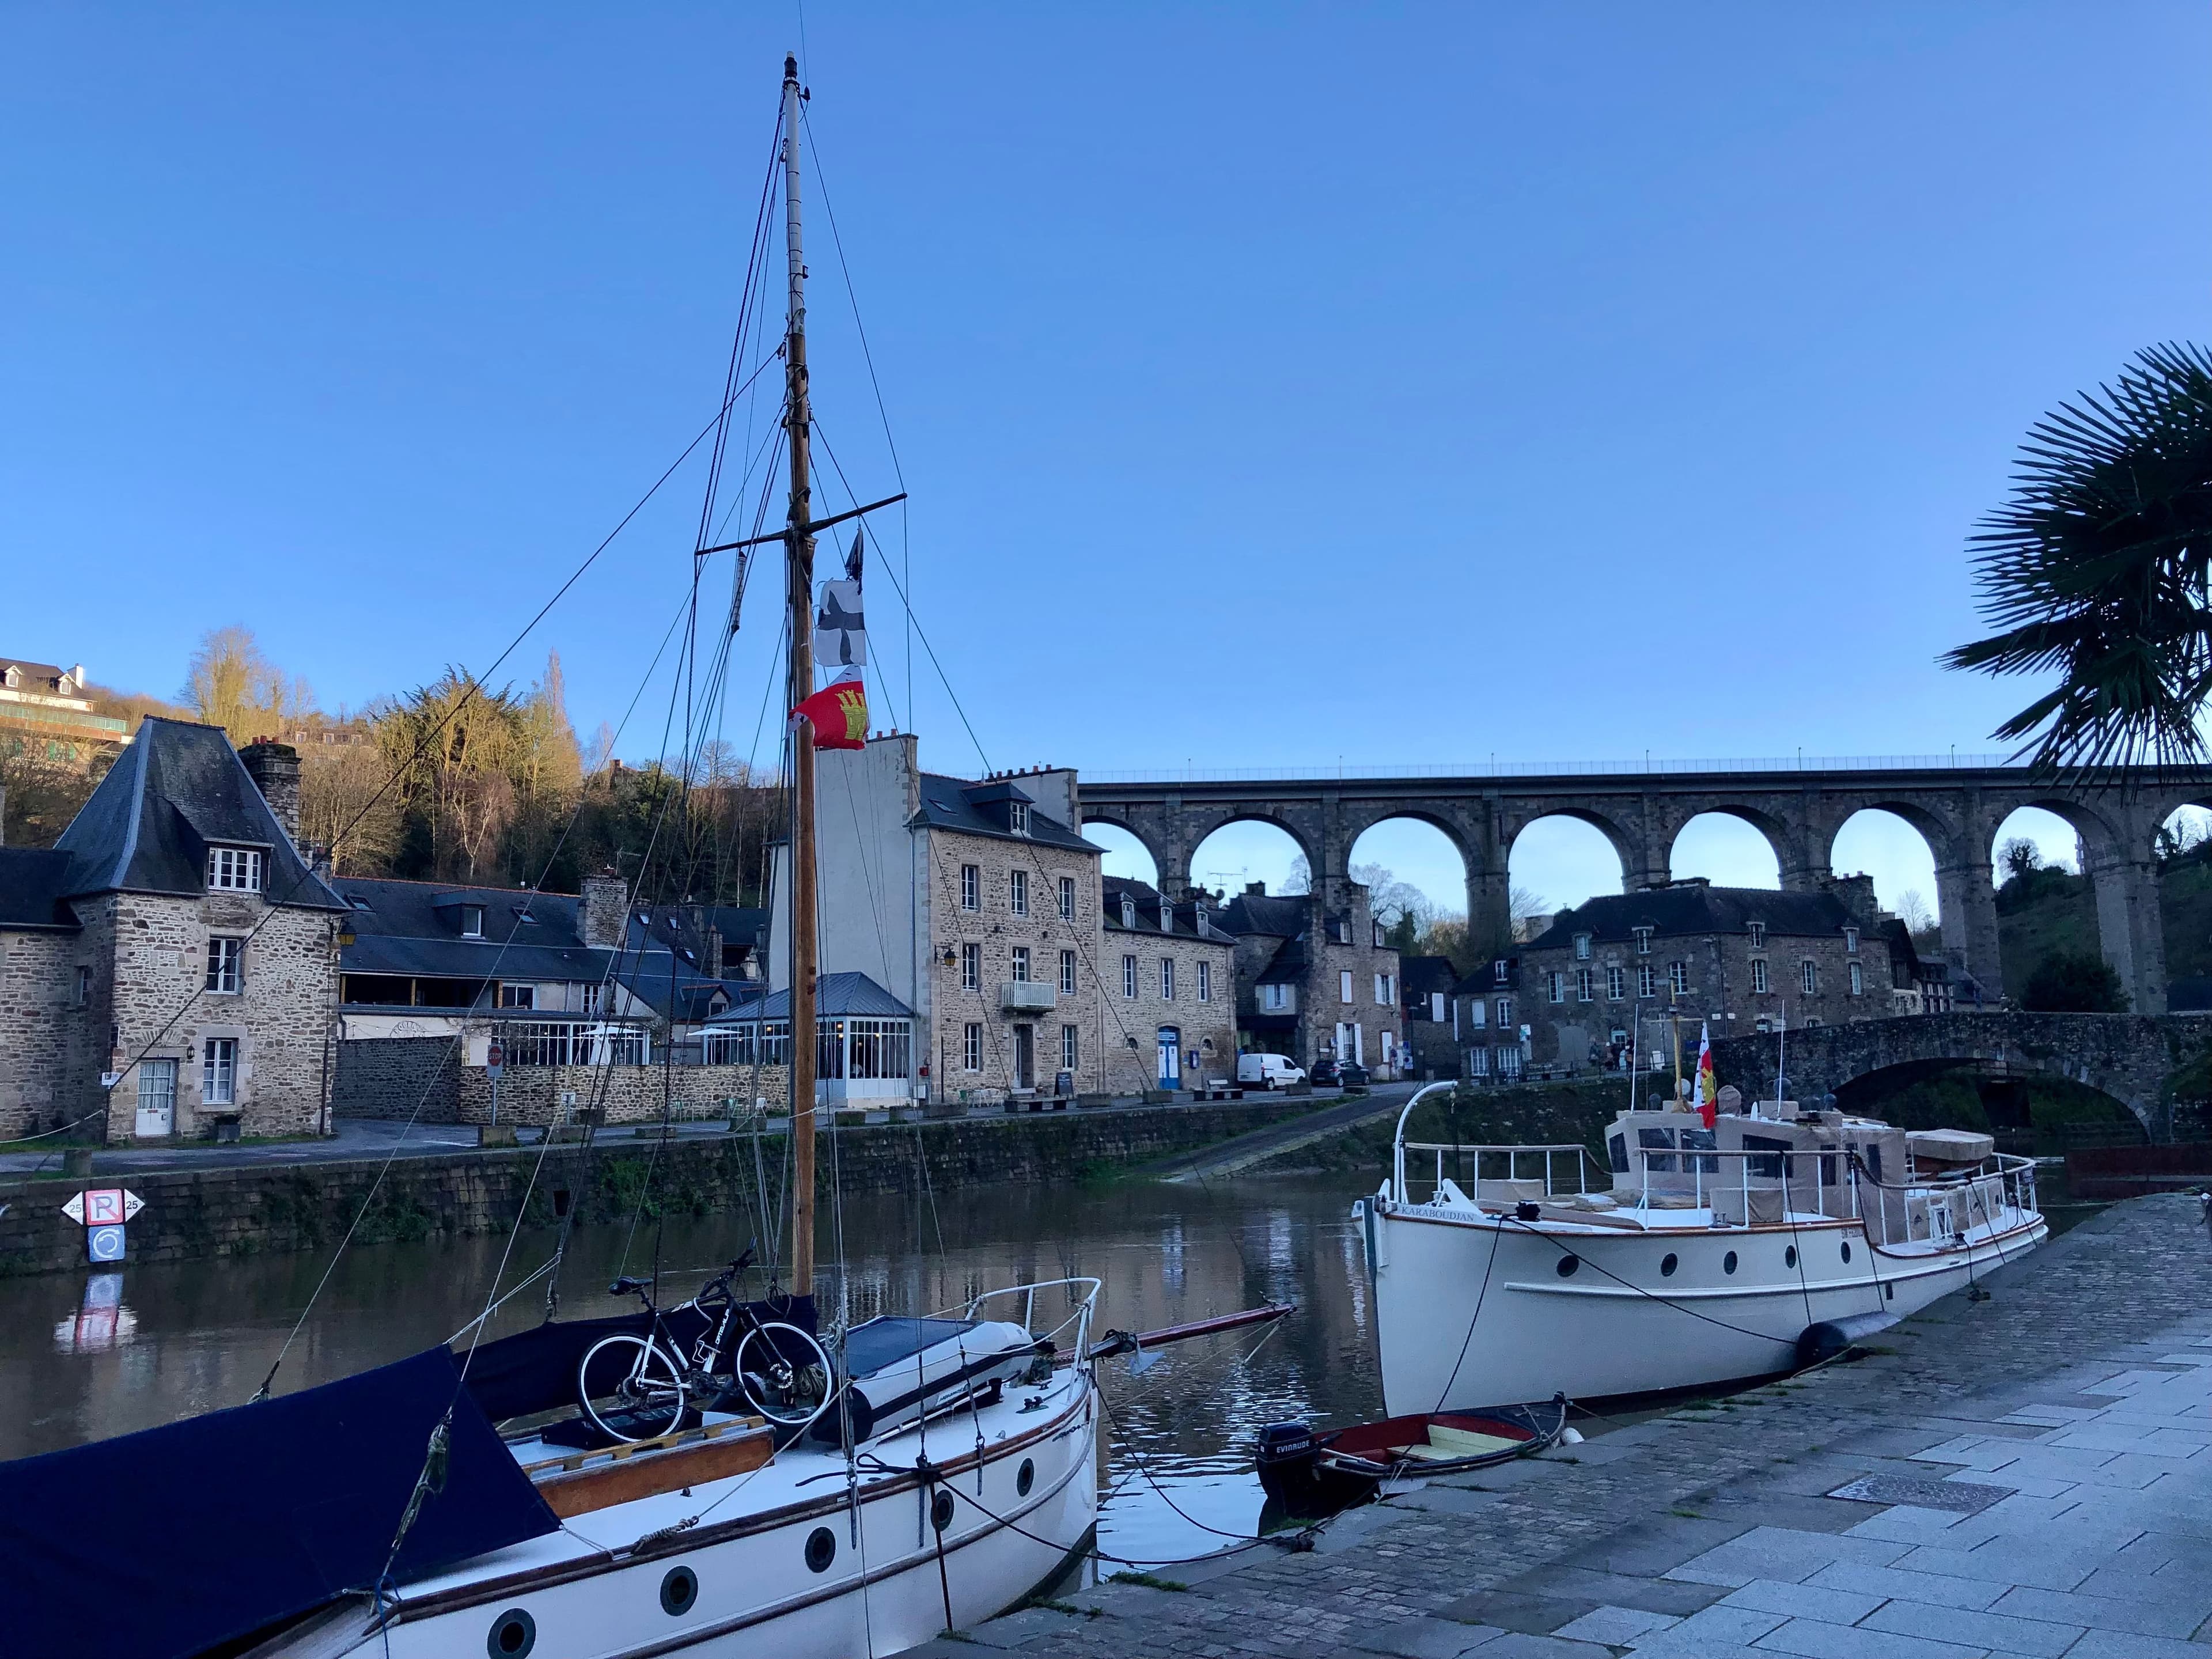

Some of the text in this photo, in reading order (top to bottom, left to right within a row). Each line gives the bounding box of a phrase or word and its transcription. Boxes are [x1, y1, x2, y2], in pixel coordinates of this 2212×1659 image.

[69, 1204, 82, 1213] 25
[126, 1200, 138, 1210] 25
[1402, 1206, 1475, 1222] KARABOUDJAN
[1277, 1440, 1310, 1453] EVINRUDE
